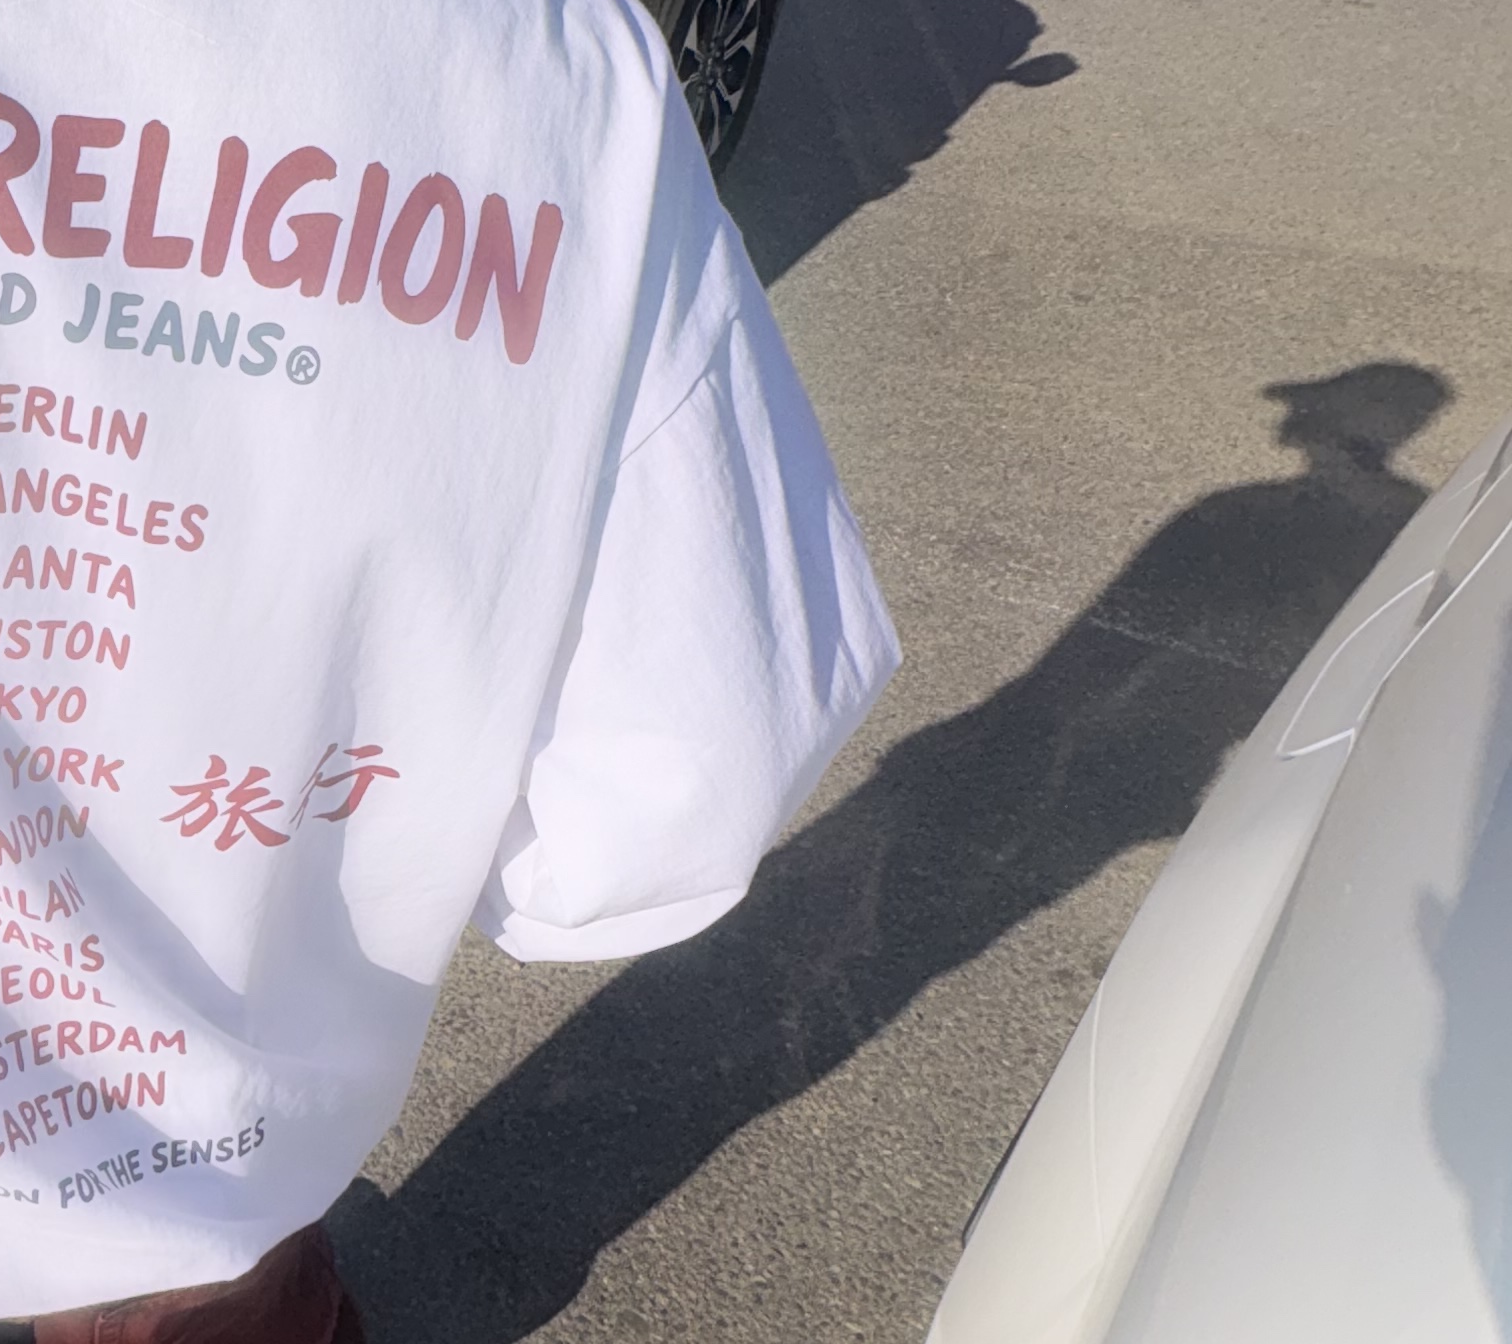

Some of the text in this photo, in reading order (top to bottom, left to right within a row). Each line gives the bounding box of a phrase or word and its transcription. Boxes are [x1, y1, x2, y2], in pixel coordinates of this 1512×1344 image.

[2, 745, 125, 793] YORK
[159, 742, 401, 852] 旅行
[152, 1117, 265, 1174] SENSES
